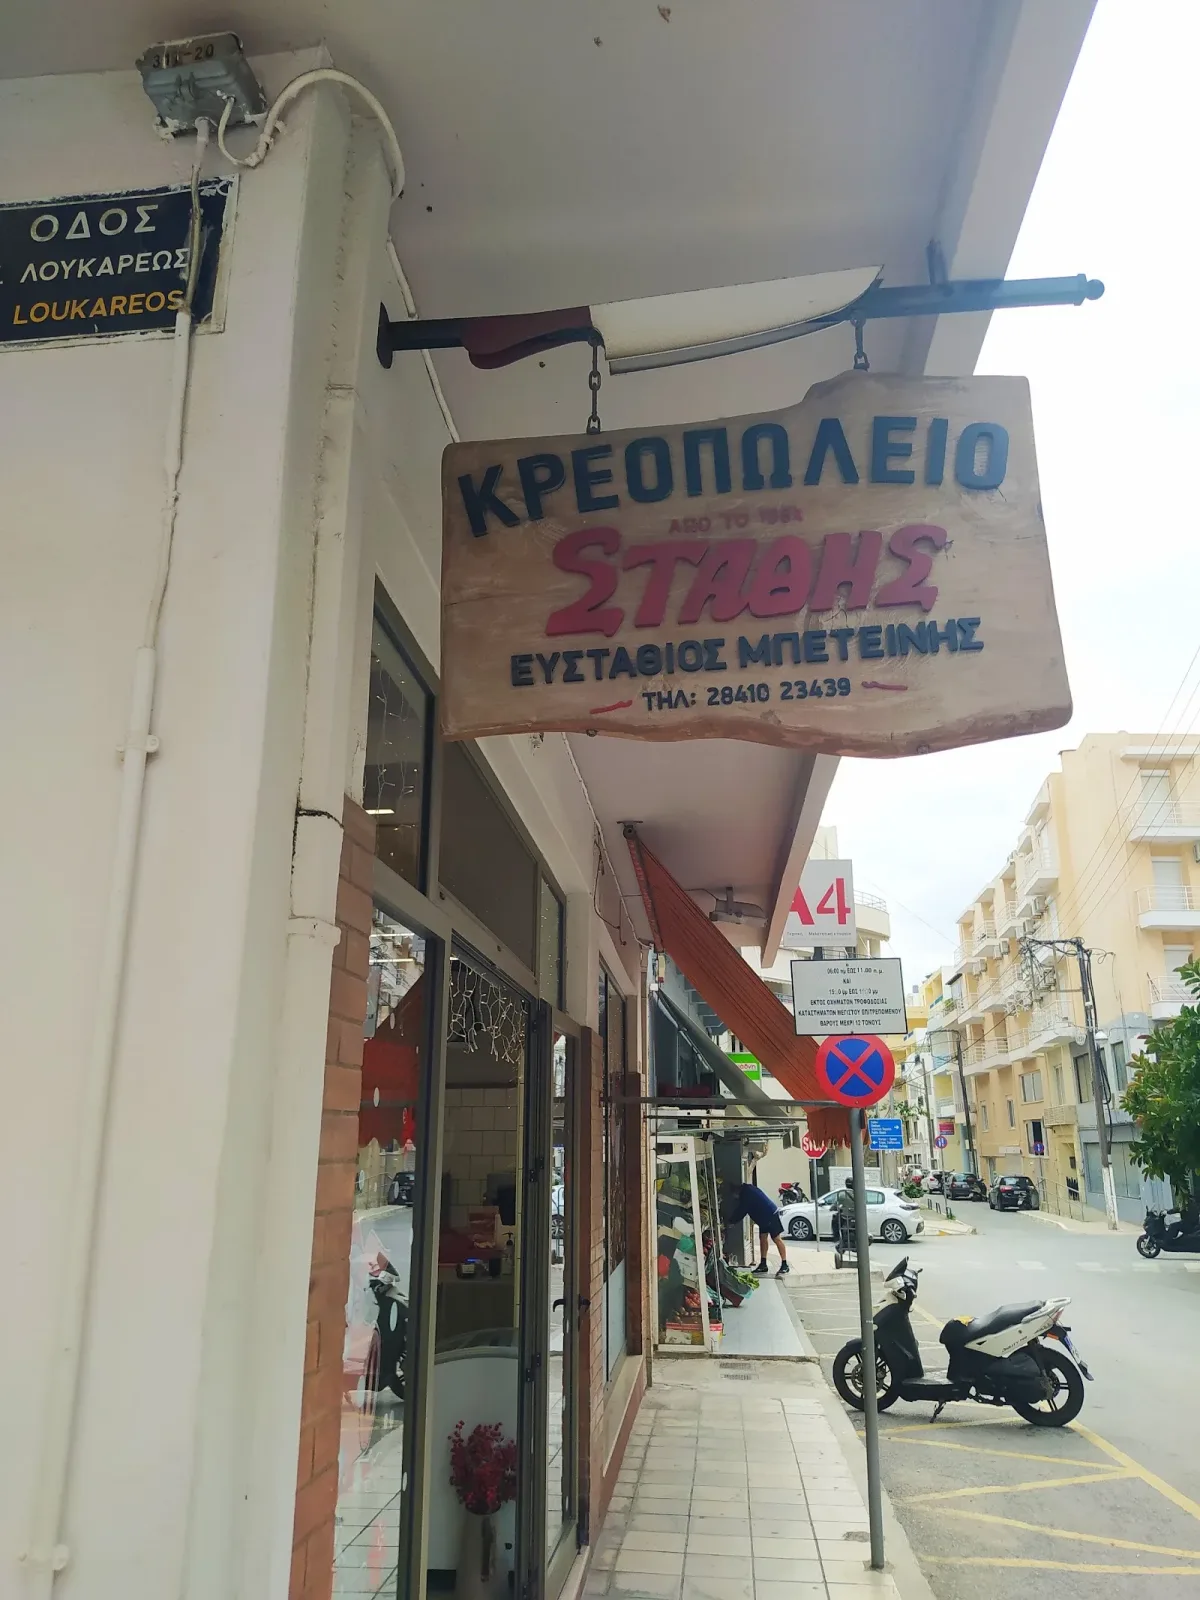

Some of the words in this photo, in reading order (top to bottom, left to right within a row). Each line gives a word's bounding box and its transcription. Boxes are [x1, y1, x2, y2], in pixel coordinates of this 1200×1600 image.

[30, 204, 158, 242] ΟΔΟΣ
[20, 247, 189, 283] ΛΟΥΚΑΡΕΩΣ
[13, 289, 184, 325] LOUKAREOS
[457, 415, 1011, 538] ΚΡΕΟΠΩΛΕΙΟ
[668, 517, 711, 534] ΑΠΟ
[719, 512, 749, 530] ΤΟ
[544, 524, 948, 637] ΣΤΑΘΗΣ
[510, 638, 727, 687] ΕΥΣΤΑΘΙΟΣ
[738, 616, 984, 669] ΜΠΕΤΕΙΝΗΣ
[642, 691, 697, 711] ΤΗΛ:
[707, 683, 770, 706] 28410
[780, 677, 851, 700] 23439
